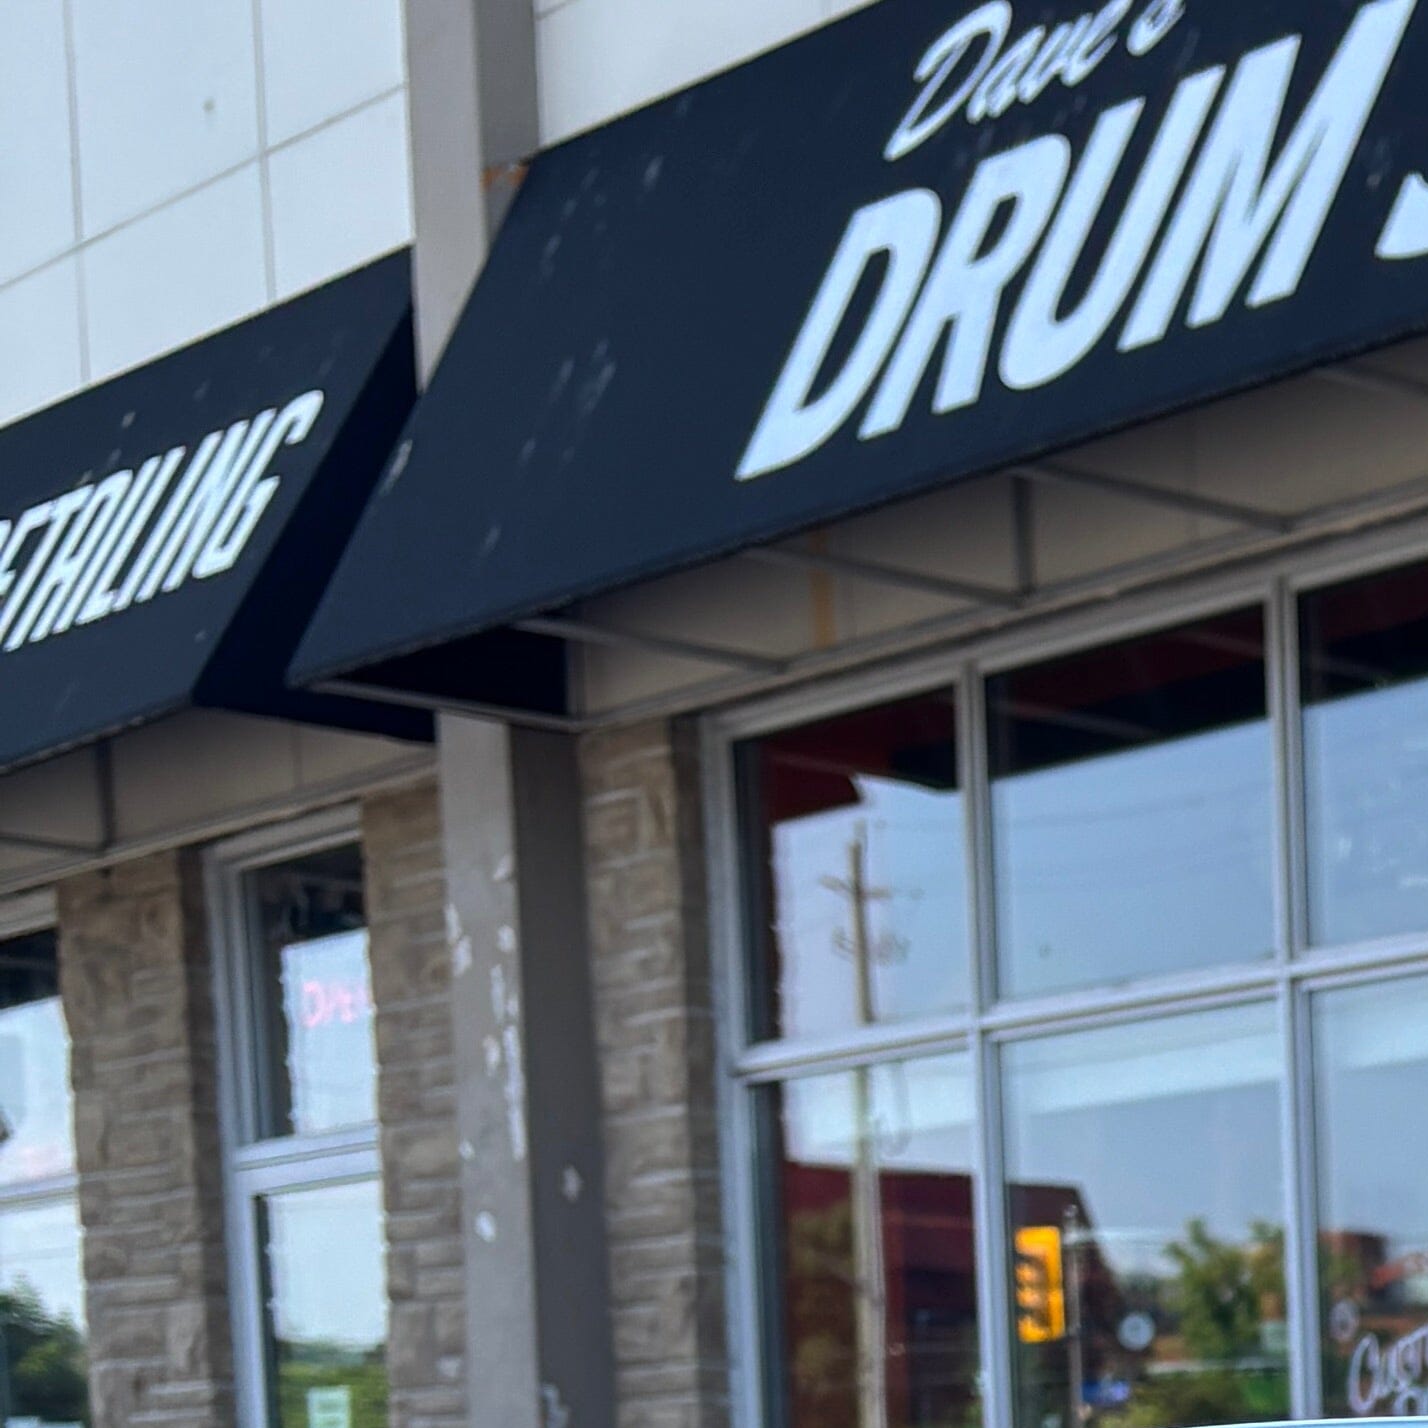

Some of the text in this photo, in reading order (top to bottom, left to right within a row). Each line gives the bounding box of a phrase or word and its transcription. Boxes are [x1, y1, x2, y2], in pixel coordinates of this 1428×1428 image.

[883, 0, 1186, 162] Daves
[734, 0, 1413, 480] DRUM
[0, 390, 324, 653] ETAILING
